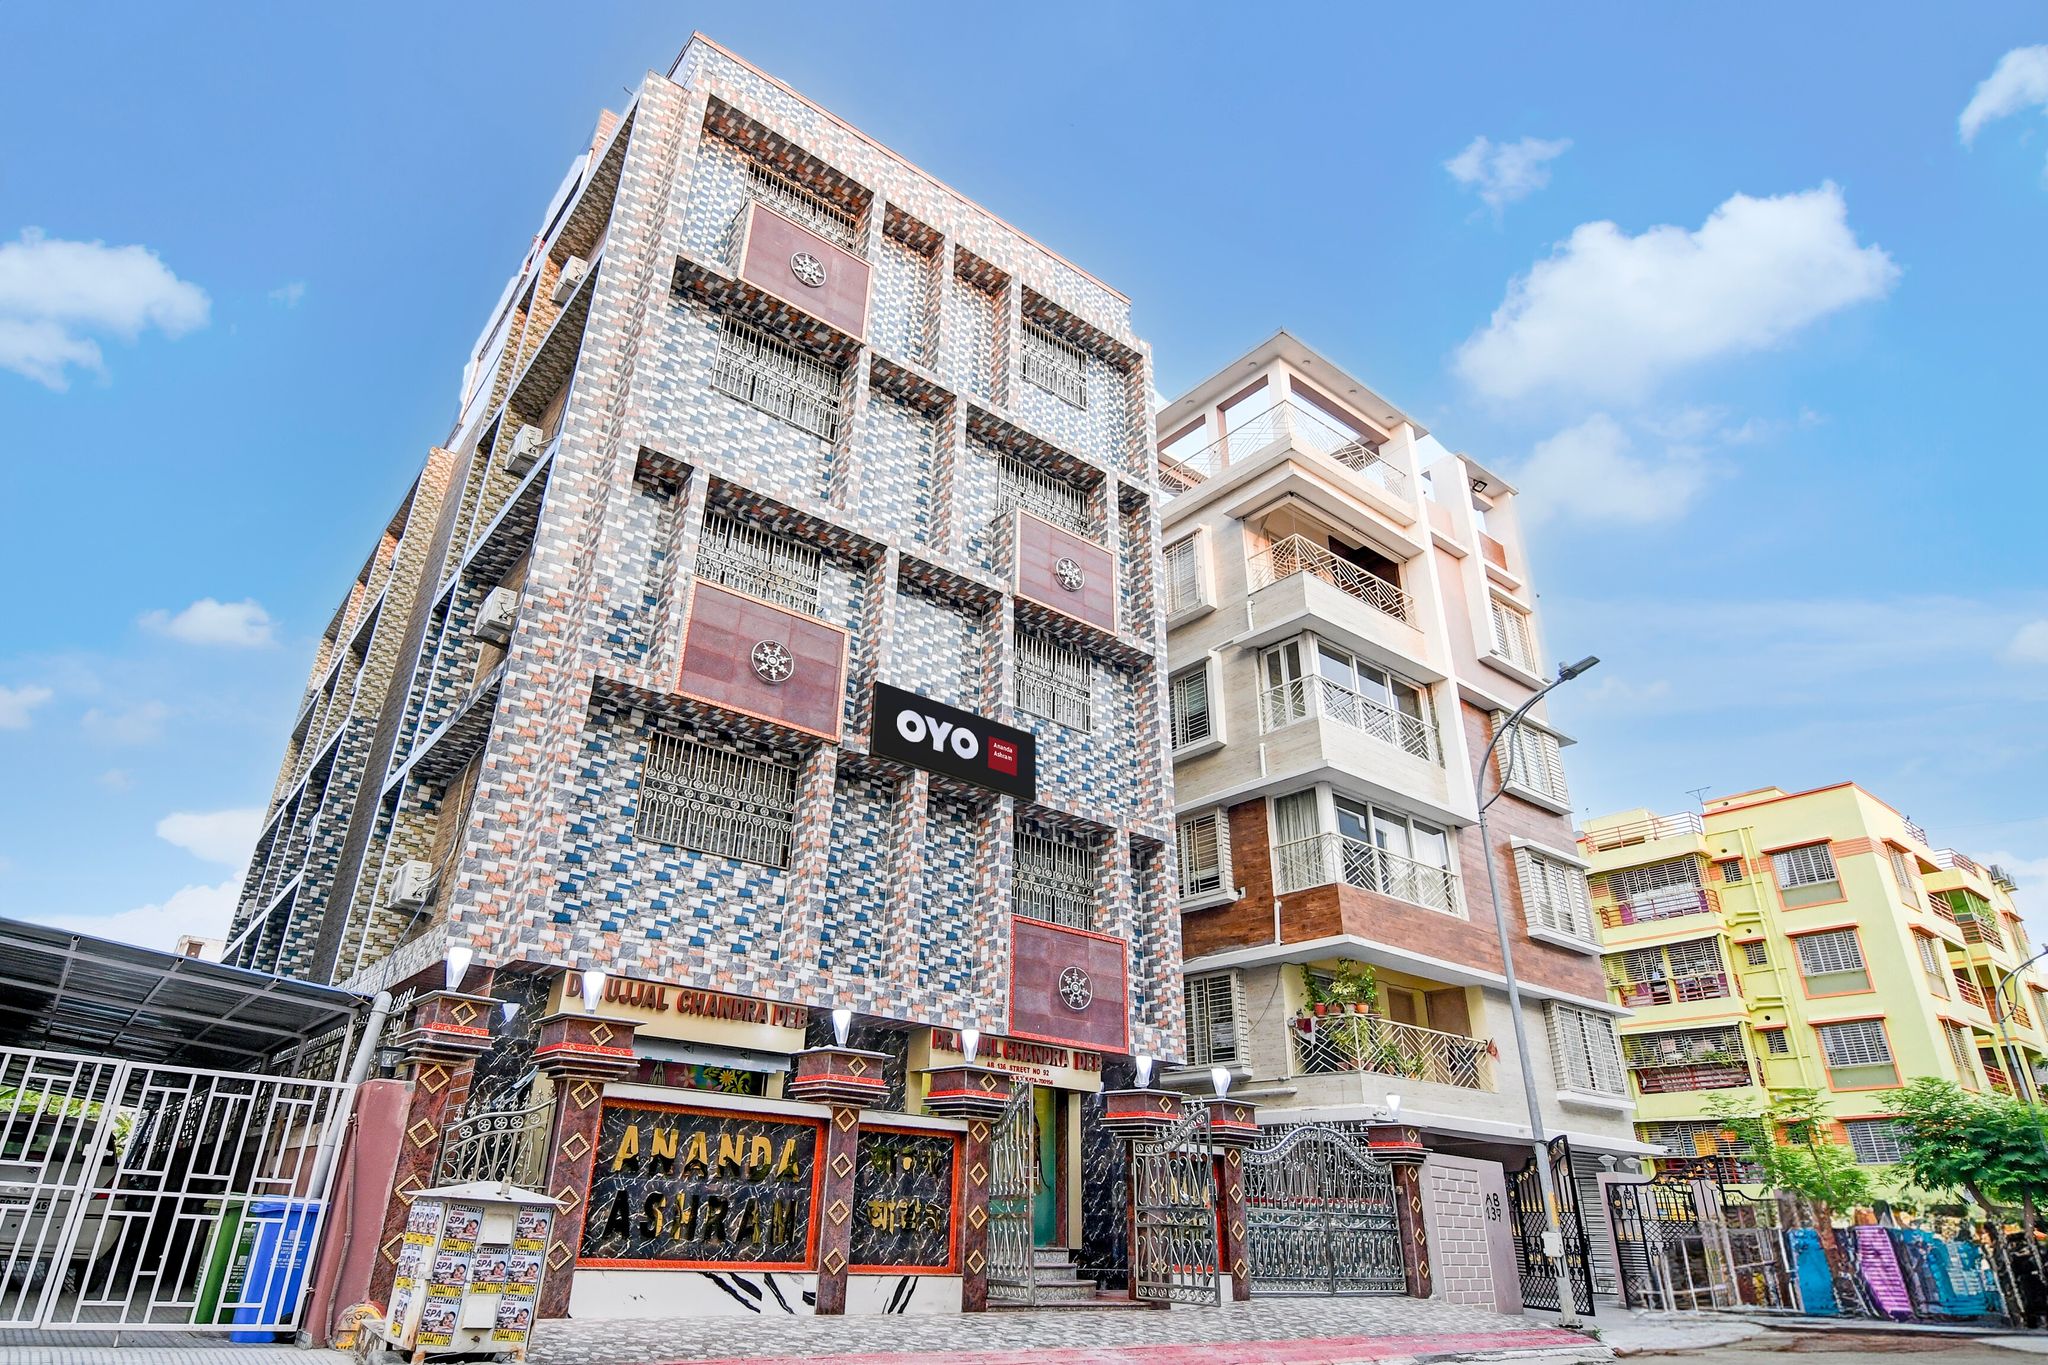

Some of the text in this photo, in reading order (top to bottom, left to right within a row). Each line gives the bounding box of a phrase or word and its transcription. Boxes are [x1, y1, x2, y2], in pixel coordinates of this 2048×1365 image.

[896, 709, 979, 760] OYO
[993, 742, 1013, 753] Ananda
[993, 750, 1013, 761] Ashram
[566, 973, 808, 1029] D. UJJAL CHANDRA DEB
[1003, 1040, 1069, 1068] CHANDRA
[1073, 1051, 1103, 1072] DEB
[987, 1061, 995, 1069] AB
[1009, 1065, 1030, 1073] STREET
[1042, 1069, 1050, 1077] 92
[611, 1125, 800, 1183] ANANDA
[1485, 1192, 1500, 1207] AB
[602, 1190, 799, 1245] ASHRAM
[1485, 1206, 1501, 1222] 137
[448, 1216, 465, 1225] SPA
[518, 1216, 535, 1225] SPA
[435, 1261, 452, 1270] SPA
[475, 1259, 492, 1268] SPA
[510, 1260, 526, 1269] SPA
[424, 1308, 441, 1318] SPA
[500, 1306, 516, 1315] SPA
